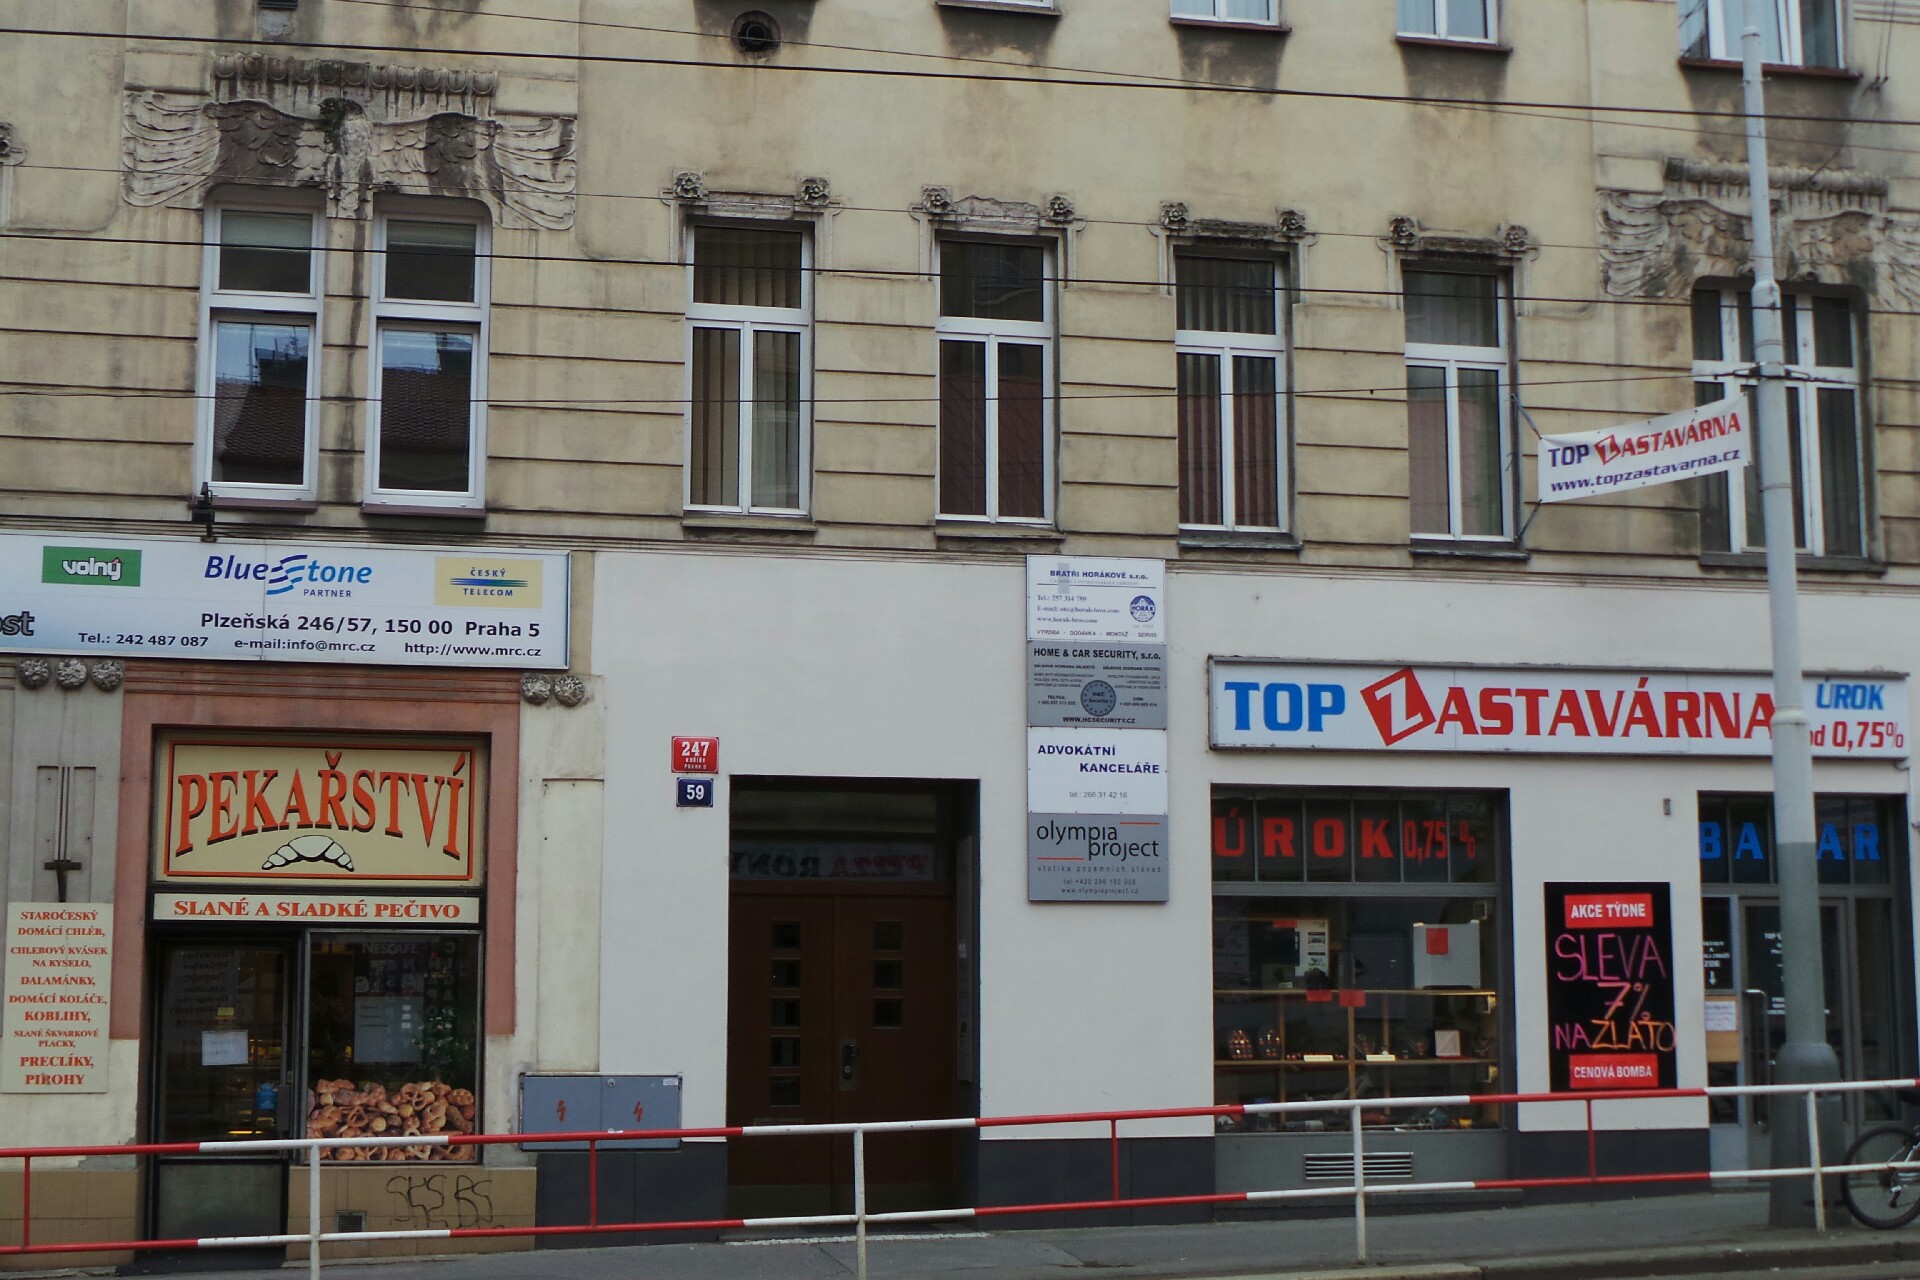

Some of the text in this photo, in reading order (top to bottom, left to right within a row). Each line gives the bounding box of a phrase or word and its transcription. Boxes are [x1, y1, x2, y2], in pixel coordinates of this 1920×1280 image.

[1548, 412, 1741, 468] TOP ZASTAVÁRNA
[1551, 449, 1741, 492] www.topzastavarna.cz
[62, 557, 122, 581] volný
[470, 567, 506, 577] ČESKÝ
[303, 588, 352, 597] PARTNER
[463, 588, 513, 596] TELECOM
[0, 611, 35, 636] st
[201, 613, 540, 637] Plzeňská 246/57, 150 00 Praha 5
[79, 632, 209, 647] Tel.: 242 487 087
[404, 643, 541, 656] http://www.mrc.cz
[1034, 648, 1161, 660] HOME & CAR SECURITY, s.r.o.
[1224, 667, 1775, 747] TOP ZASTAVÁRNA
[1832, 720, 1905, 751] 0,75%
[681, 741, 710, 757] 247
[1038, 744, 1116, 756] ADVOKÁTNÍ
[1080, 762, 1160, 774] KANCELÁŘE
[686, 784, 705, 800] 59
[175, 751, 466, 860] PEKAŘSTVÍ
[1036, 820, 1118, 845] olympia
[1212, 808, 1394, 858] ÚROK
[1700, 821, 1880, 860] BAAR
[1088, 840, 1159, 861] project
[21, 910, 98, 920] STAROČESKÝ
[174, 897, 460, 918] SLANÉ A SLADKÉ PEČIVO
[1571, 901, 1646, 918] AKCE TÝDNE
[18, 926, 105, 937] DOMÁCÍ CHLÉB,
[10, 945, 108, 955] CHLEBOVÝ KVÁSEK
[1555, 934, 1666, 981] SLEVA
[49, 960, 91, 968] KYSELO,
[20, 974, 96, 986] DALAMÁNKY,
[9, 993, 56, 1003] DOMÁCÍ
[24, 1011, 91, 1023] KOBLIHY,
[14, 1029, 99, 1037] SLANÉ ŠKVARKOVÉ
[1555, 1020, 1677, 1051] NA ZLATO
[20, 1053, 94, 1068] PRECLÍKY,
[1574, 1063, 1652, 1078] CENOVÁ BOMBA
[25, 1074, 85, 1085] PIROHY
